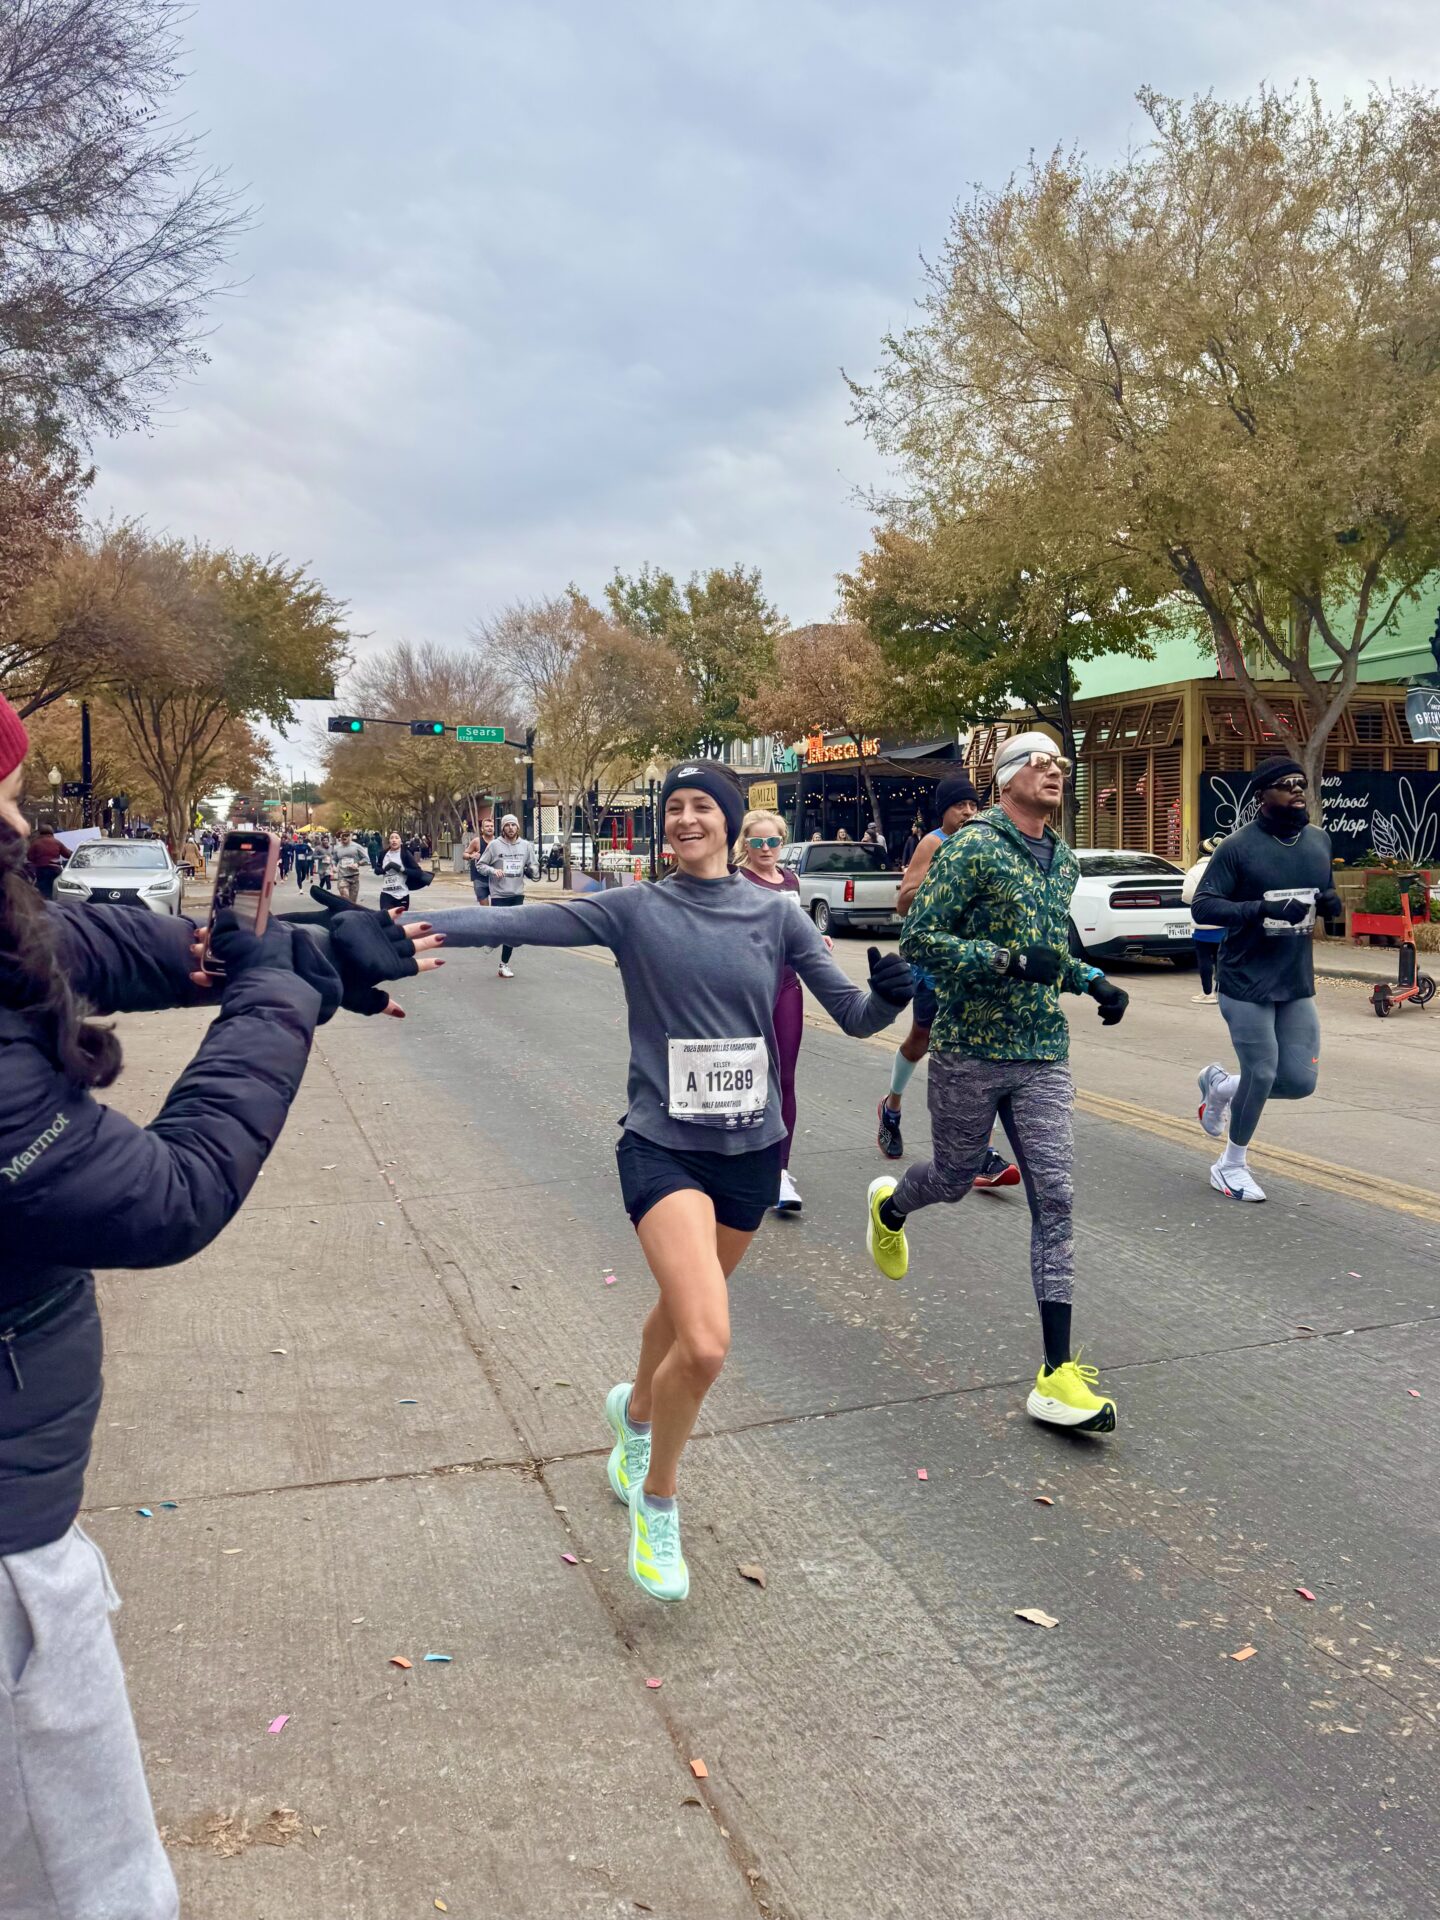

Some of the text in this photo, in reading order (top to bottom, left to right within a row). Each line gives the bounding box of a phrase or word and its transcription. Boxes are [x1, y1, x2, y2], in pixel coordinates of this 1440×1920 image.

[466, 728, 496, 736] Sears
[757, 787, 776, 803] MIZU
[1322, 793, 1370, 809] orhood
[1329, 813, 1369, 838] shop
[729, 1043, 757, 1051] MARATHON
[686, 1069, 753, 1092] A 11289
[701, 1101, 715, 1109] HALF
[0, 1112, 70, 1182] Marmot
